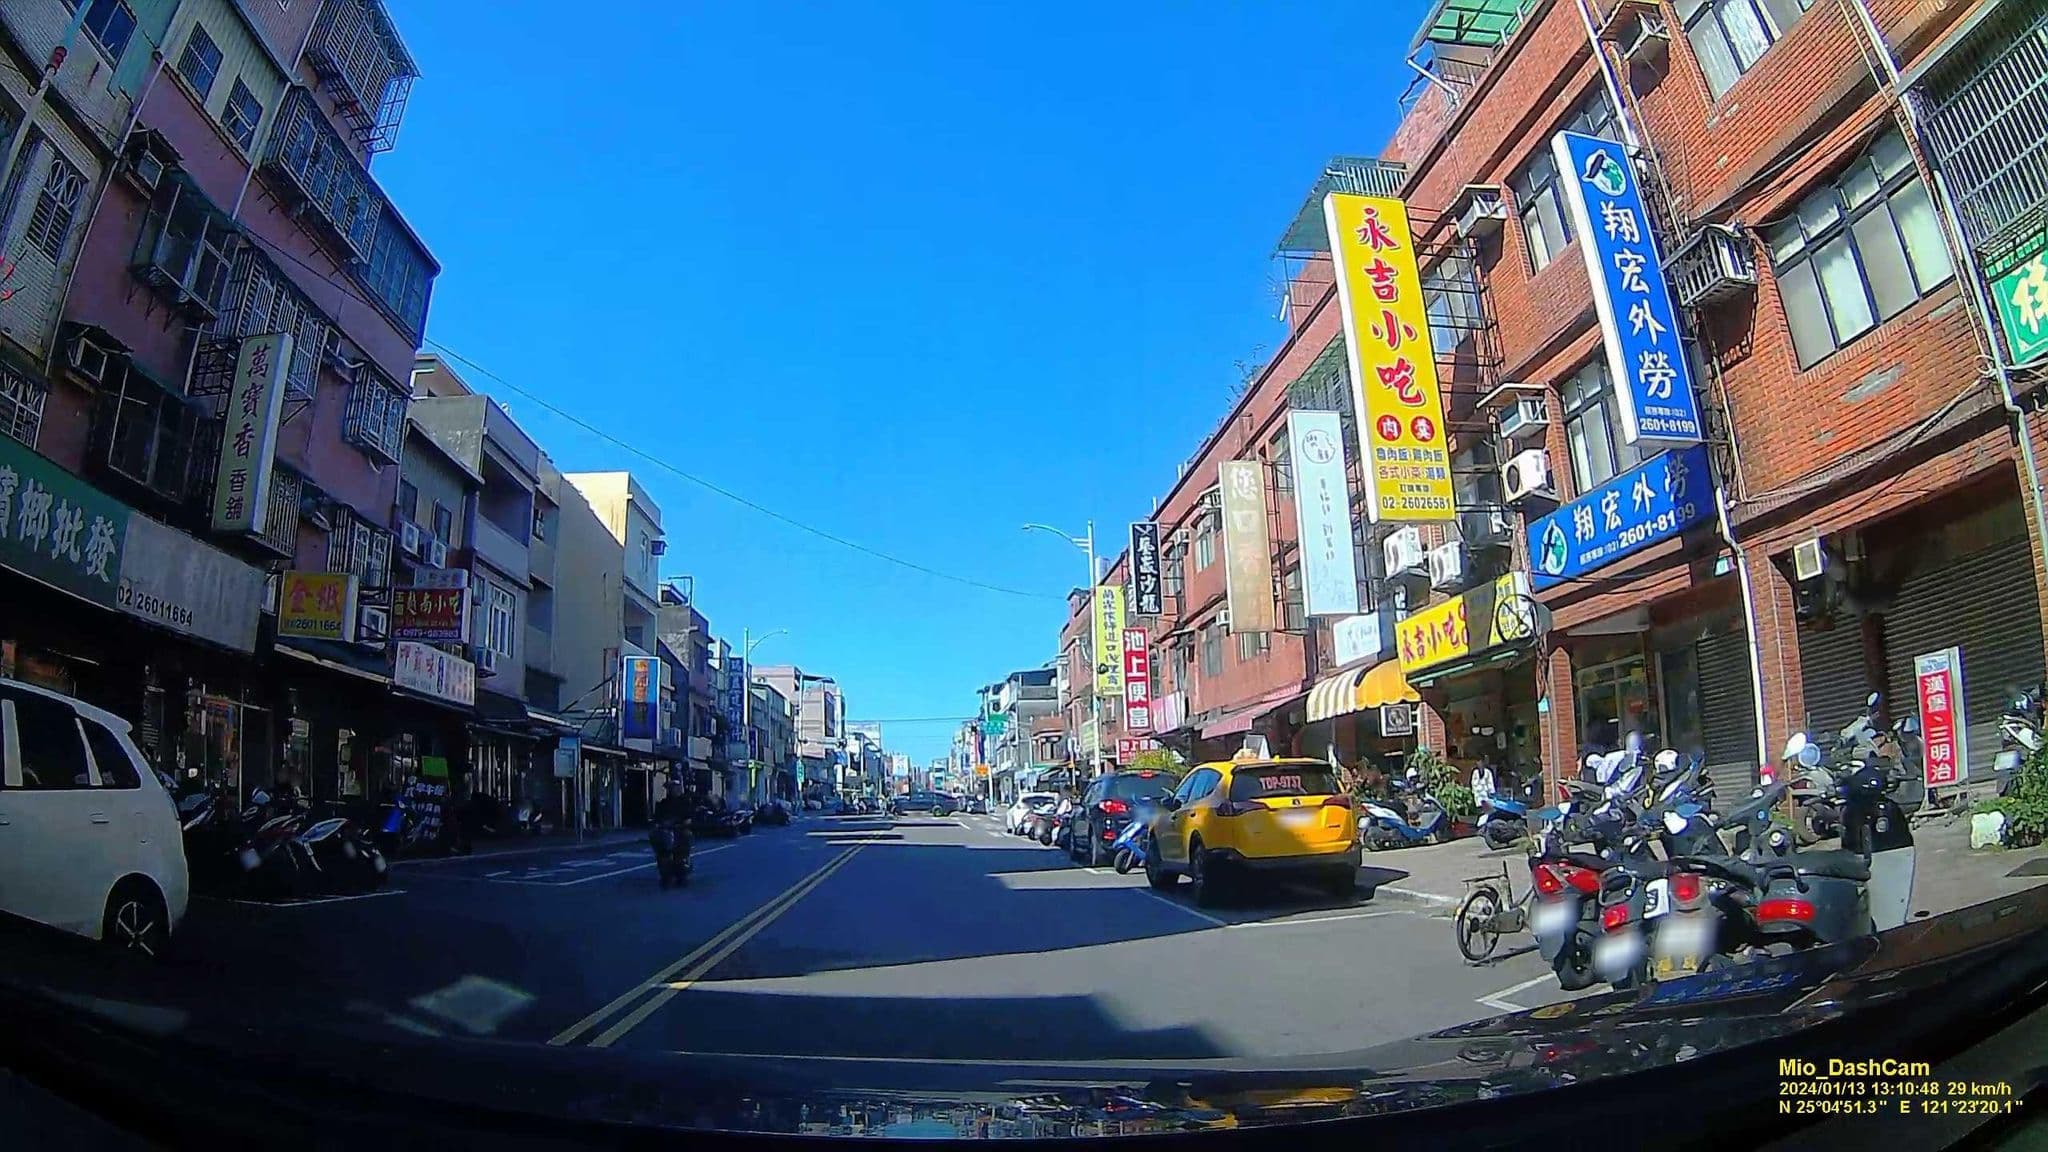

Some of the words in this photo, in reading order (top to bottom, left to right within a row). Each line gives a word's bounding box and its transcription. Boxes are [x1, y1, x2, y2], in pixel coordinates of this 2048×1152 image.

[1355, 207, 1426, 407] 永吉小吃
[1600, 202, 1677, 400] 翔宏外勞
[233, 343, 270, 460] 萬寶香
[1640, 418, 1695, 433] 2601-8199
[1382, 496, 1450, 510] 02-26026581
[1573, 454, 1690, 545] 翔宏外勞
[1619, 503, 1696, 548] 2601-8199
[118, 586, 133, 606] 02
[137, 593, 193, 627] 26011664
[1403, 611, 1460, 664] 永吉小吃
[1123, 631, 1149, 728] 池上便當
